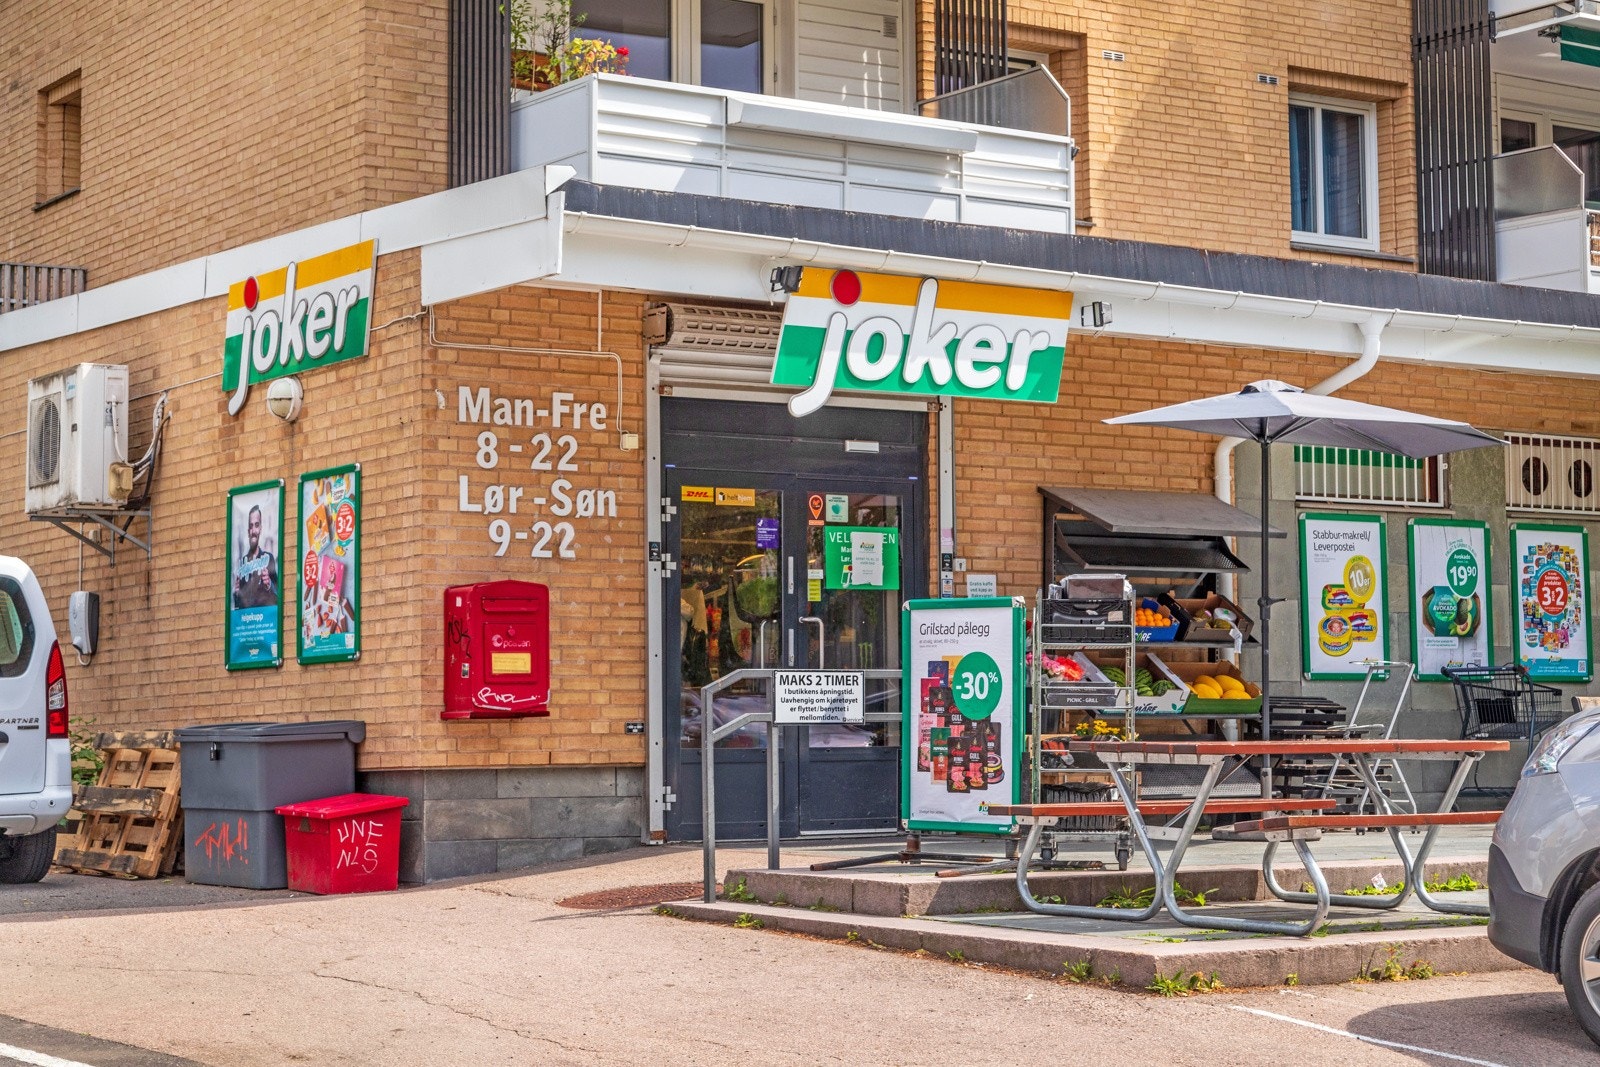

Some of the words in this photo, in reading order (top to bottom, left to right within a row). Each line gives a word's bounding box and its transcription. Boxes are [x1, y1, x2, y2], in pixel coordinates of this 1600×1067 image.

[229, 261, 360, 417] joker
[788, 268, 1051, 418] joker
[458, 385, 607, 430] Man-Fre
[686, 490, 709, 498] DHL
[727, 493, 753, 503] helthjem
[1312, 529, 1371, 542] Stabbur-makrell/
[1313, 542, 1356, 553] Leverpostei
[919, 622, 956, 636] Grilstad
[957, 621, 990, 637] pålegg
[779, 674, 813, 686] MAKS
[815, 675, 822, 686] 2
[824, 675, 859, 686] TIMER
[820, 688, 854, 697] åpningstid.
[780, 697, 815, 705] Uavhengig
[826, 697, 858, 705] kjøretøyet
